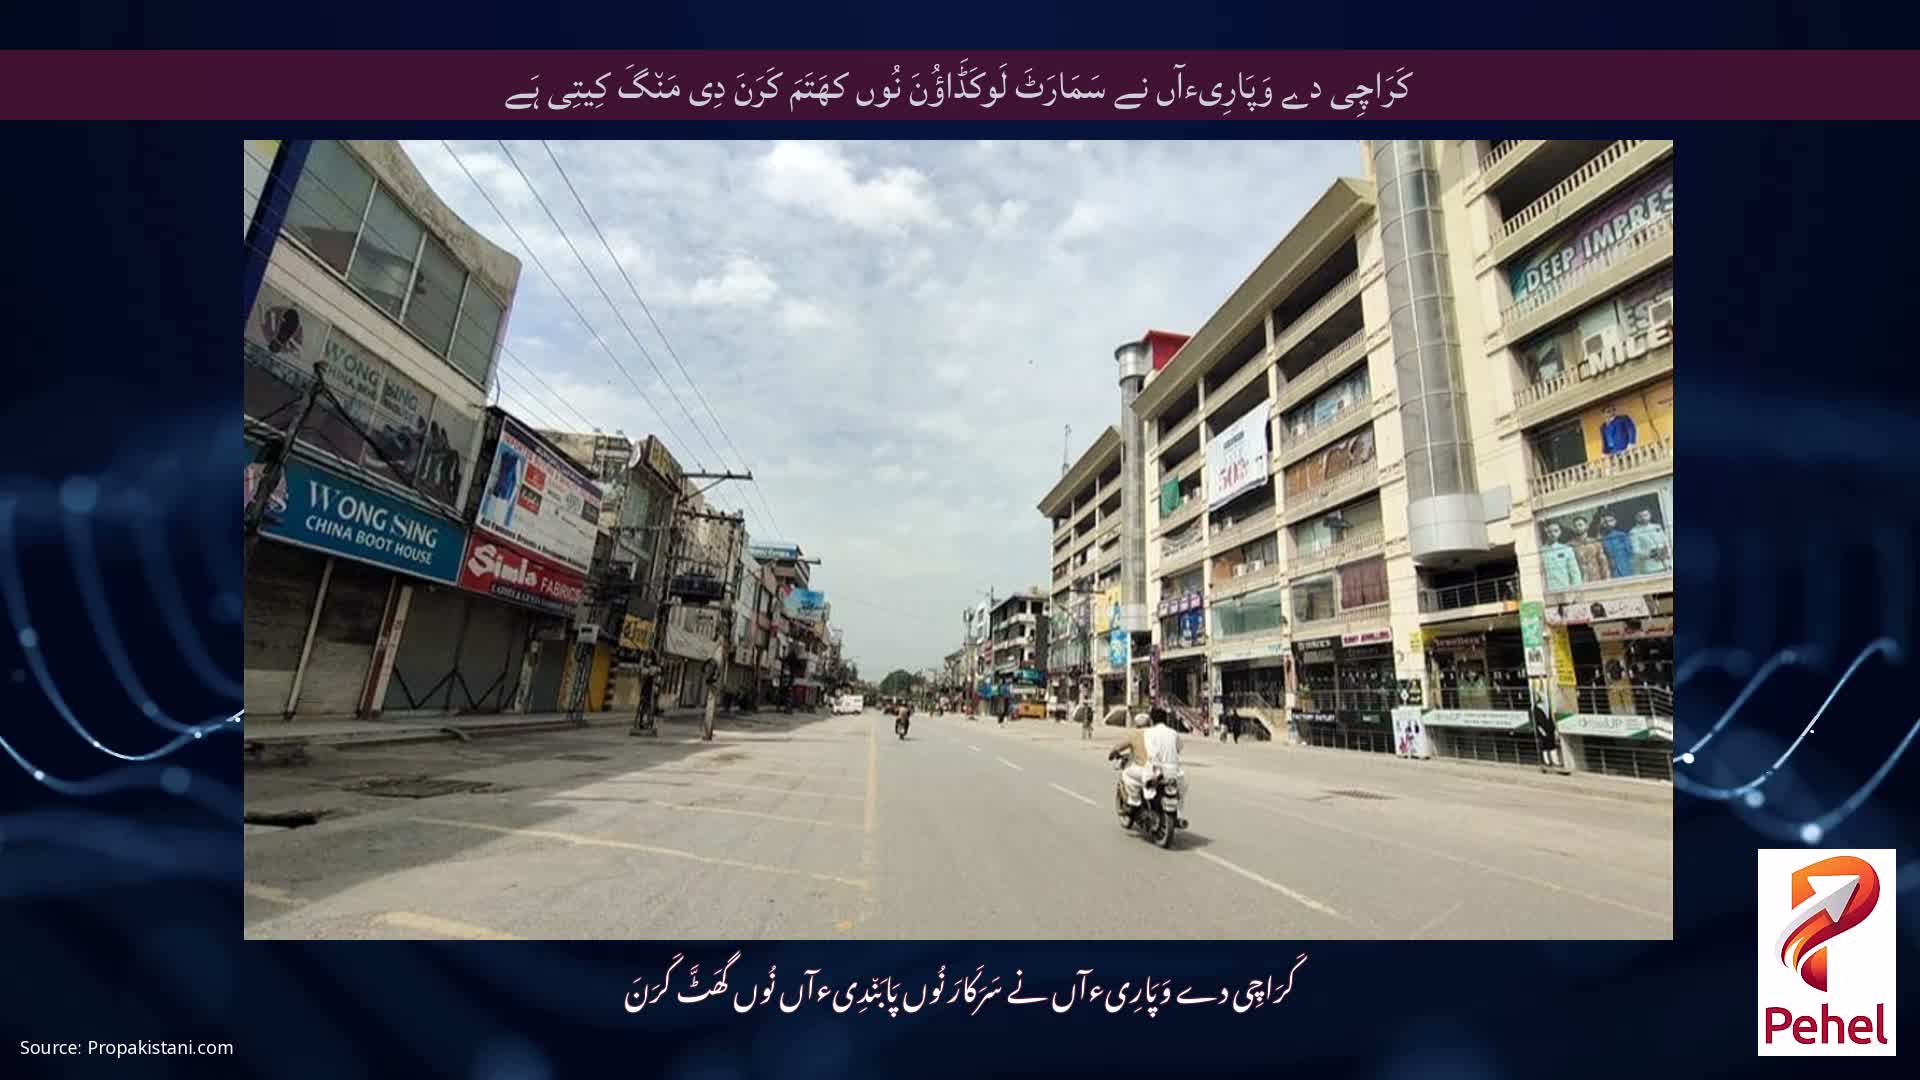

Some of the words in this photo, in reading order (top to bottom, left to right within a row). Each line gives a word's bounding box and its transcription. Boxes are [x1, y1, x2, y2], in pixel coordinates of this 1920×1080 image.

[1525, 245, 1576, 295] DEEP
[305, 514, 353, 543] CHINA
[355, 528, 393, 553] BOOT
[394, 541, 433, 566] HOUSE
[308, 480, 389, 531] WONG
[390, 514, 439, 550] SING
[468, 543, 538, 587] Simla
